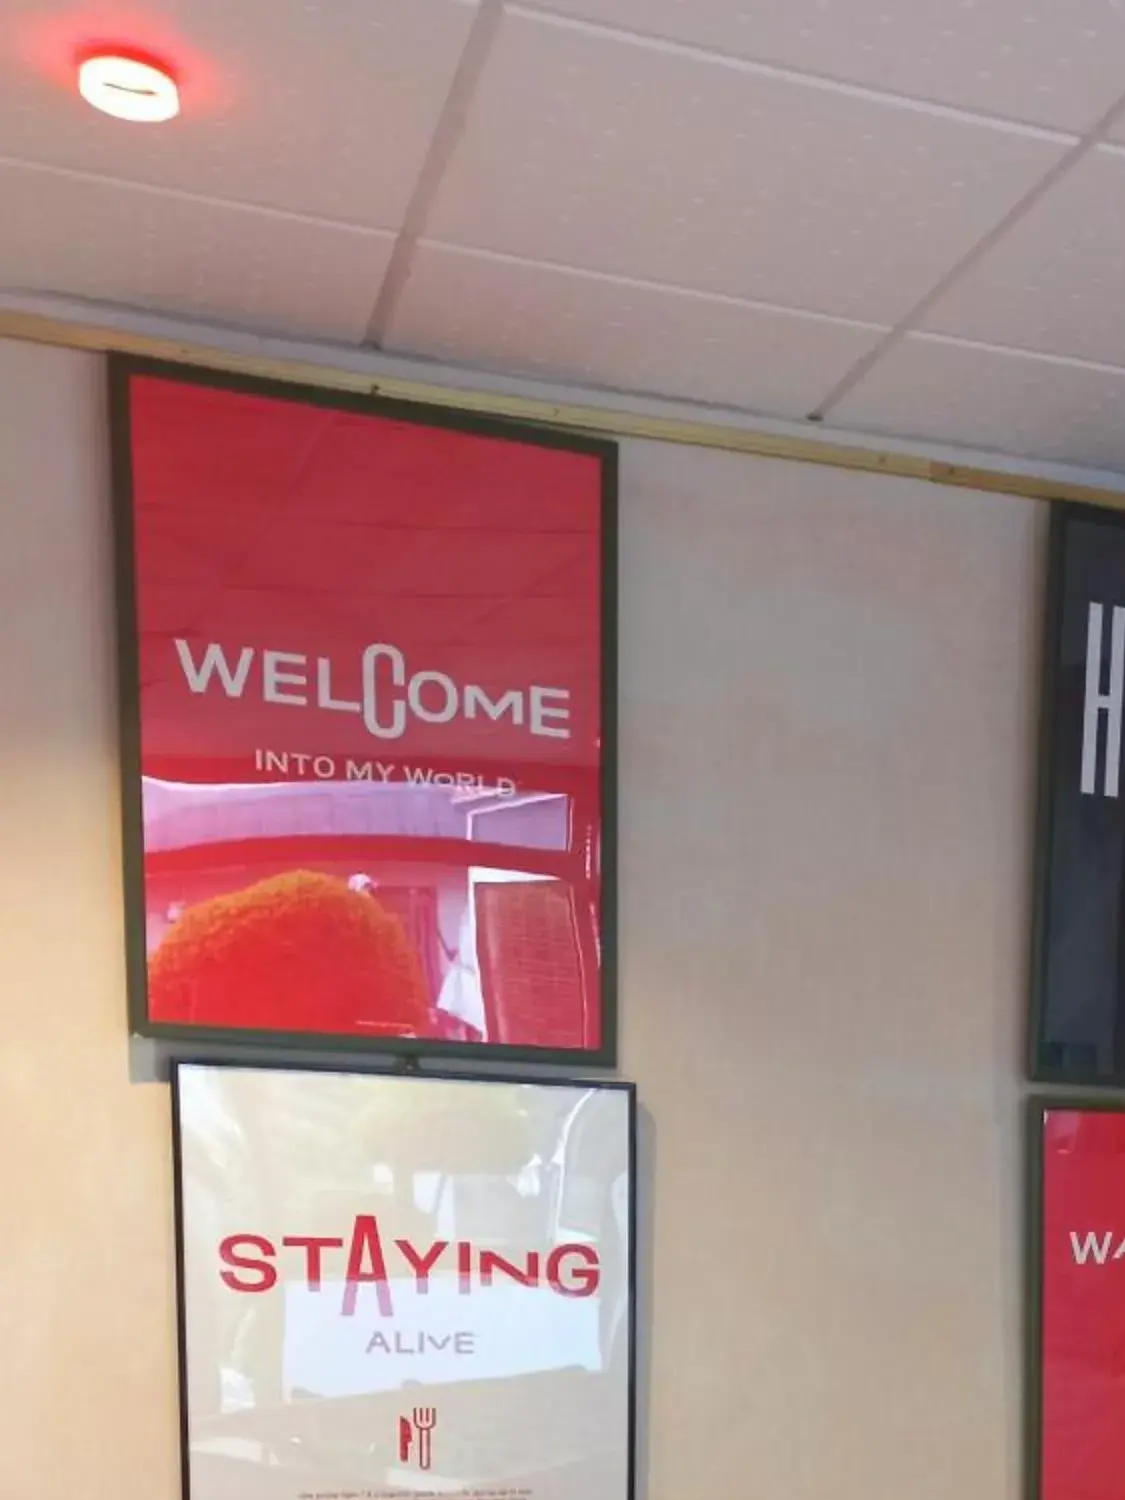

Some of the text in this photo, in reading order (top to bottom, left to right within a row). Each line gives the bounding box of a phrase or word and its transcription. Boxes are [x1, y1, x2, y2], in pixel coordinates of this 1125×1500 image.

[174, 638, 570, 739] WELCOME
[254, 747, 335, 778] INTO
[345, 760, 395, 784] MY
[219, 1215, 600, 1317] STAYING
[365, 1332, 475, 1355] ALIVE
